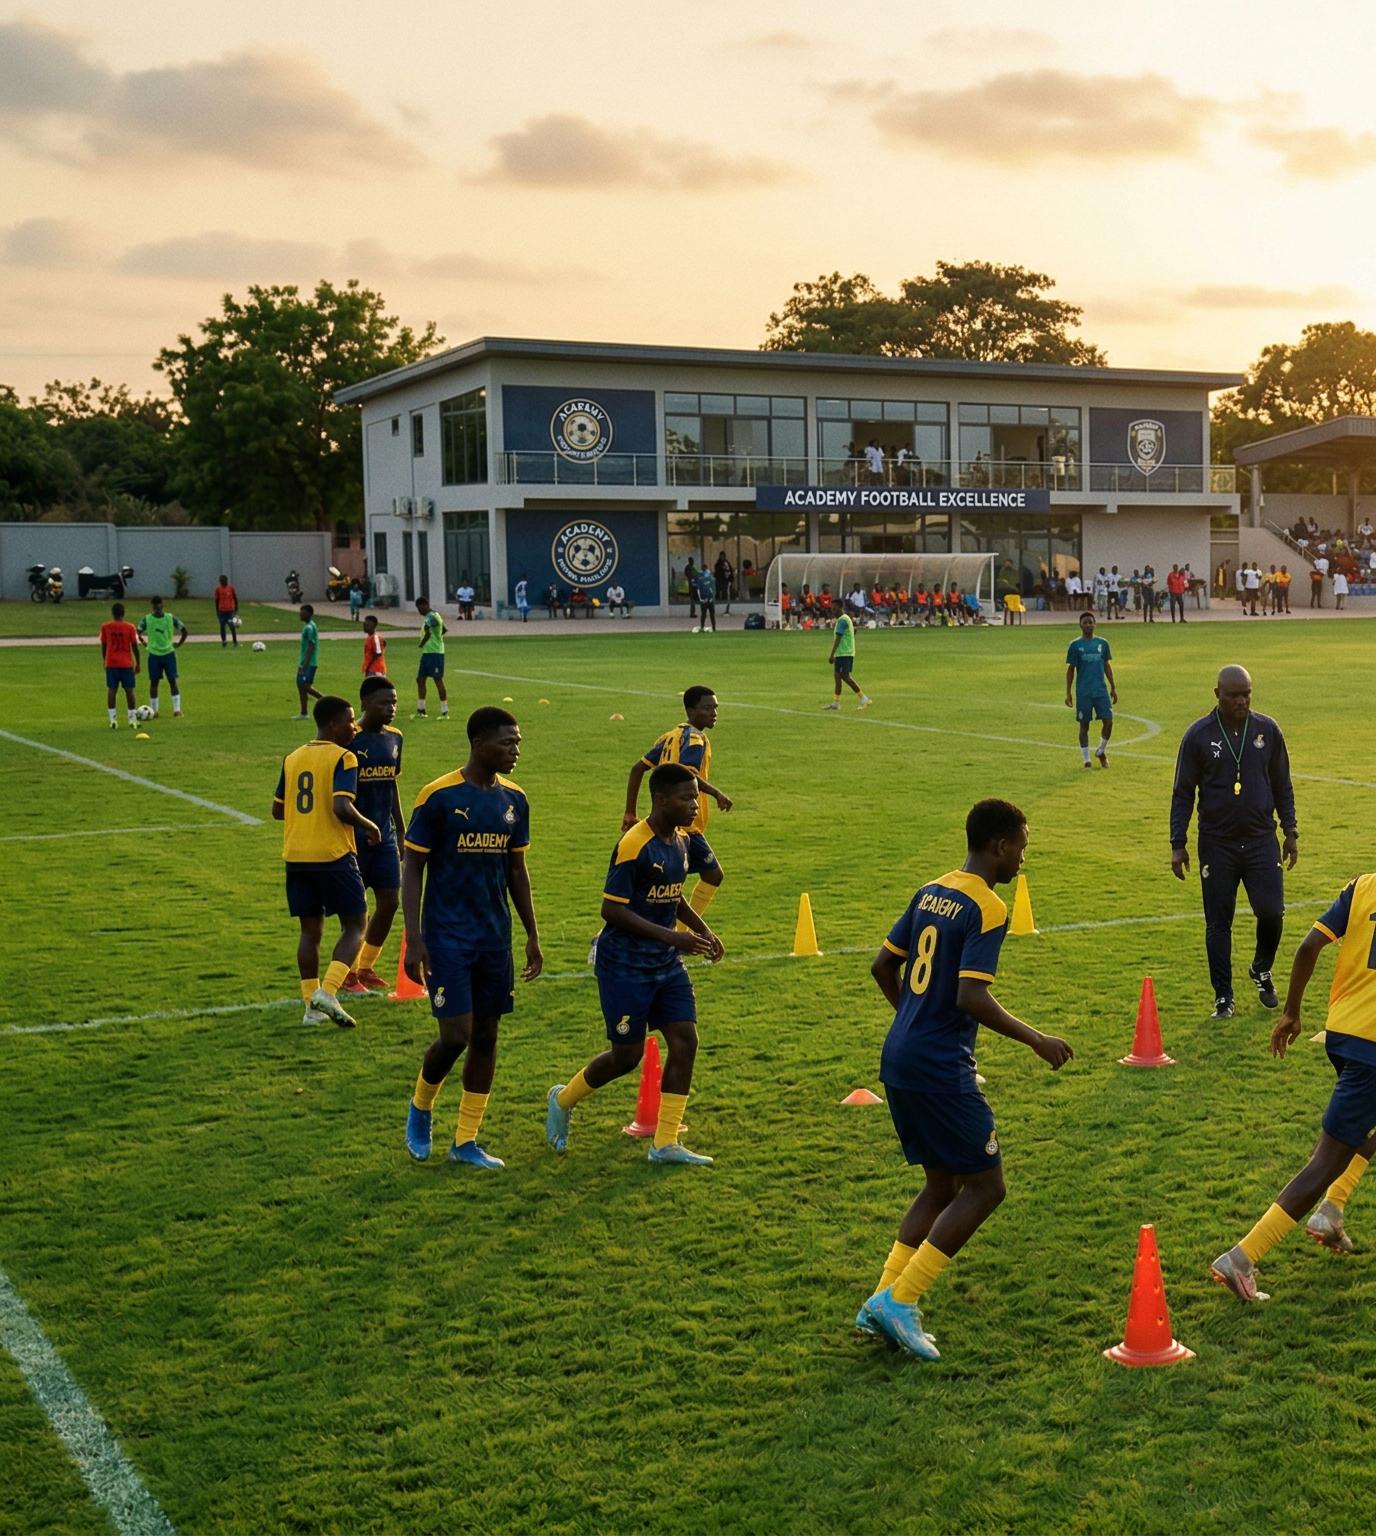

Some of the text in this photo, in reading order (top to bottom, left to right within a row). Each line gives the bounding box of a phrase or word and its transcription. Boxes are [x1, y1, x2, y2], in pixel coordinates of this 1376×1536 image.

[784, 489, 1026, 507] ACADEMY FOOTBALL EXCELLENCE
[296, 770, 314, 814] 8
[909, 925, 937, 995] 8
